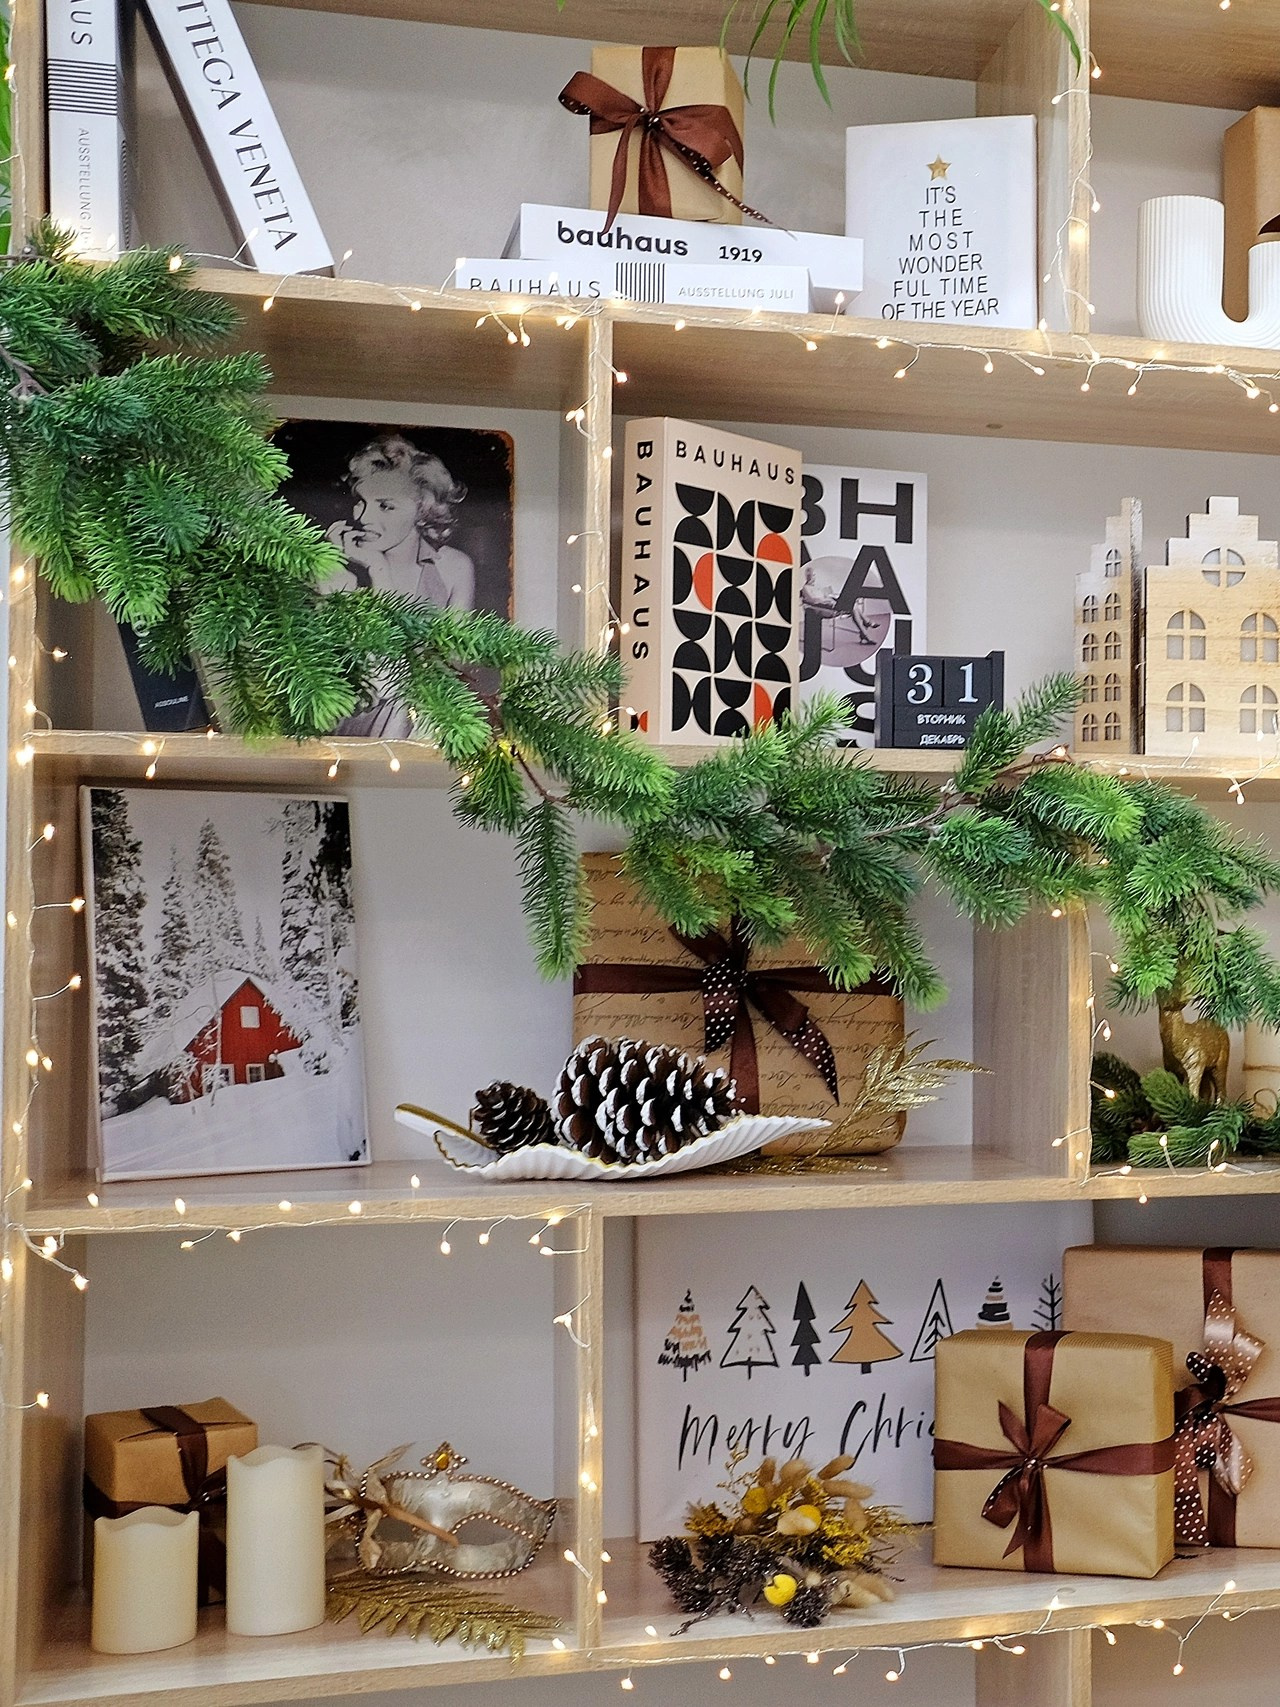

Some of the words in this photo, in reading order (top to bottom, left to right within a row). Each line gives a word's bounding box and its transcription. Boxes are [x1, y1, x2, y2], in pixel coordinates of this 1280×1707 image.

[78, 128, 92, 222] AUSSTELLUNG
[228, 118, 298, 251] VENETA
[925, 185, 956, 205] IT'S
[919, 208, 963, 228] THE
[557, 220, 689, 257] bauhaus
[719, 245, 763, 264] 1919
[909, 231, 974, 252] MOST
[899, 253, 983, 275] WONDER
[470, 278, 600, 299] BAUHAUS
[678, 286, 765, 300] AUSSTELLUNG
[769, 289, 794, 300] JULI
[894, 279, 931, 298] FUL
[940, 275, 988, 295] TIME
[881, 303, 905, 320] OF
[911, 301, 946, 319] THE
[951, 298, 999, 317] YEAR
[675, 439, 796, 485] BAUHAUS
[632, 440, 654, 661] BAUHAUS
[916, 713, 966, 725] ВТОРНИК
[919, 734, 966, 746] ДЕКАБРЬ
[678, 1405, 815, 1470] Merry
